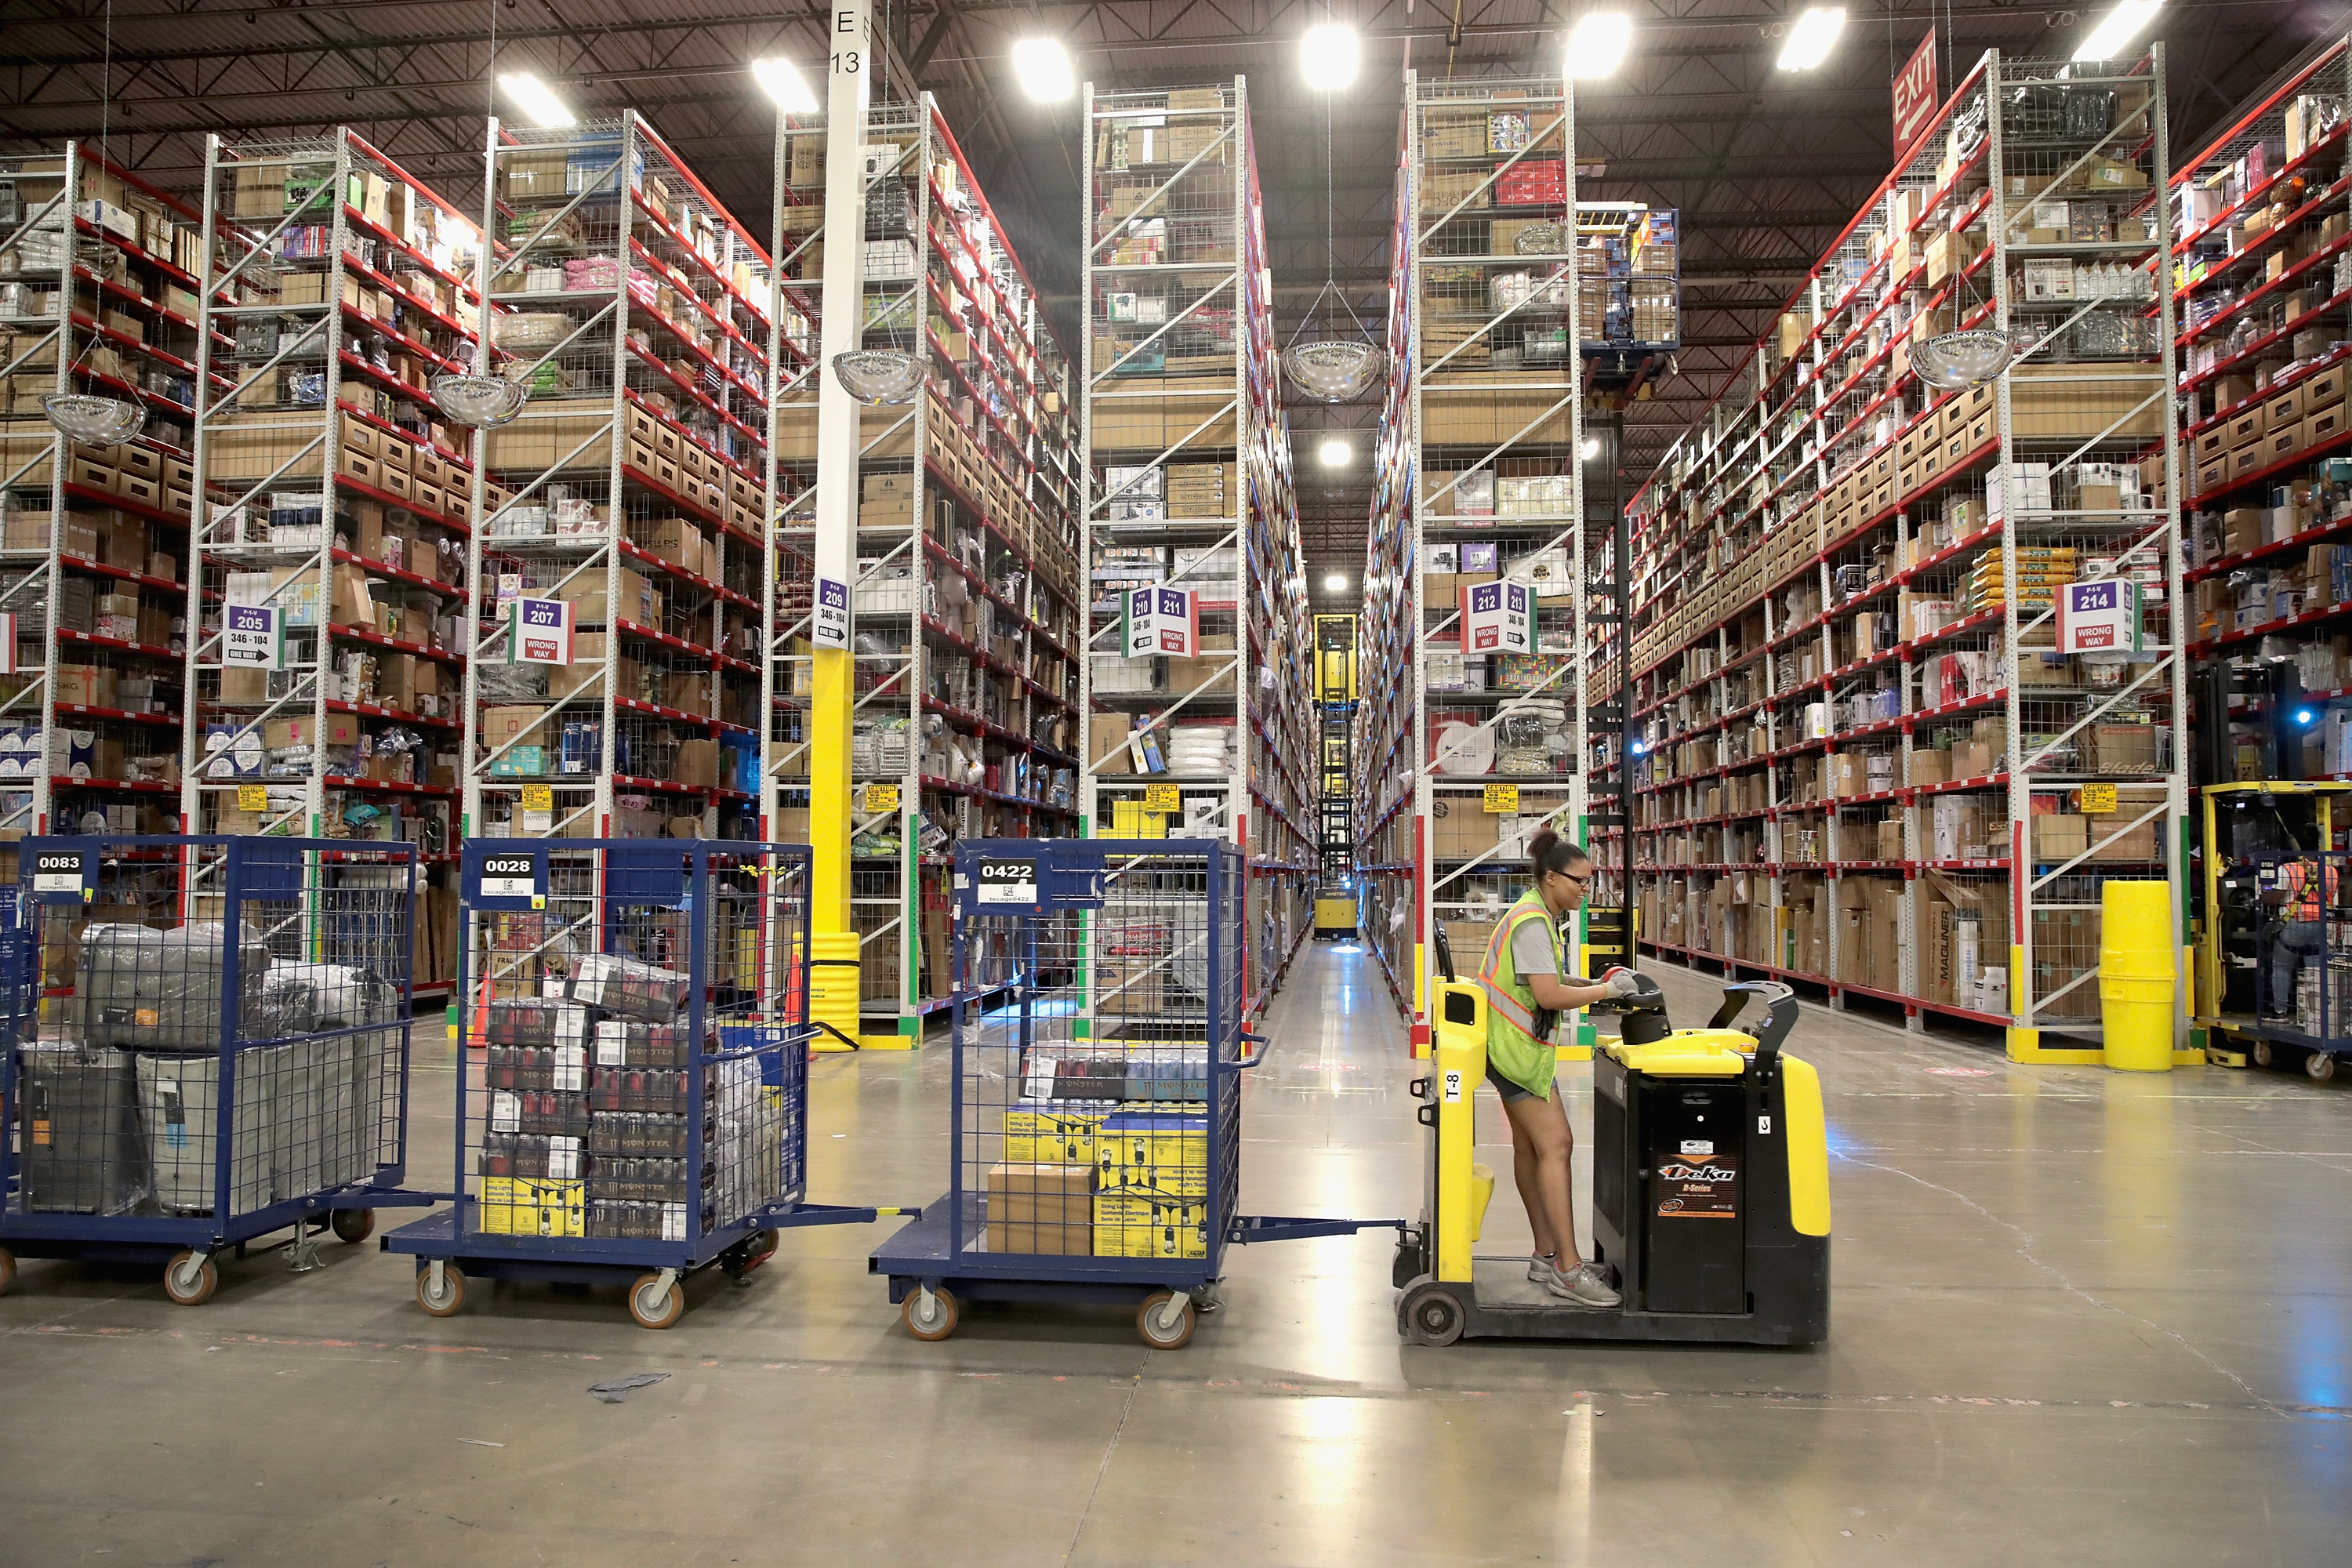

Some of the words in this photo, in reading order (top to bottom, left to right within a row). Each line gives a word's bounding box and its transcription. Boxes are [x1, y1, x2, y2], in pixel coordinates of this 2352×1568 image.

[838, 11, 854, 32] E
[831, 52, 859, 74] 13
[1894, 38, 1933, 125] EXIT
[825, 590, 843, 607] 209
[1478, 595, 1496, 611] 212
[1511, 595, 1523, 611] 213
[2080, 593, 2108, 609] 214
[821, 608, 833, 620] 346
[1135, 600, 1149, 615] 210
[1163, 600, 1180, 615] 211
[237, 616, 263, 630] 205
[530, 611, 554, 624] 207
[1162, 631, 1183, 641] WRONG
[1476, 627, 1497, 637] WRONG
[2078, 626, 2112, 637] WRONG
[231, 633, 247, 644] 346
[253, 635, 268, 645] 104
[527, 640, 556, 650] WRONG
[1480, 637, 1493, 647] WAY
[2085, 637, 2104, 646] WAY
[1167, 641, 1179, 651] WAY
[533, 649, 550, 659] WAY
[39, 857, 79, 868] 0083
[486, 860, 530, 872] 0028
[982, 866, 1033, 877] 0422
[1940, 910, 1949, 980] MAGLINER
[1446, 1074, 1459, 1098] T-8
[1659, 1165, 1734, 1181] Deka
